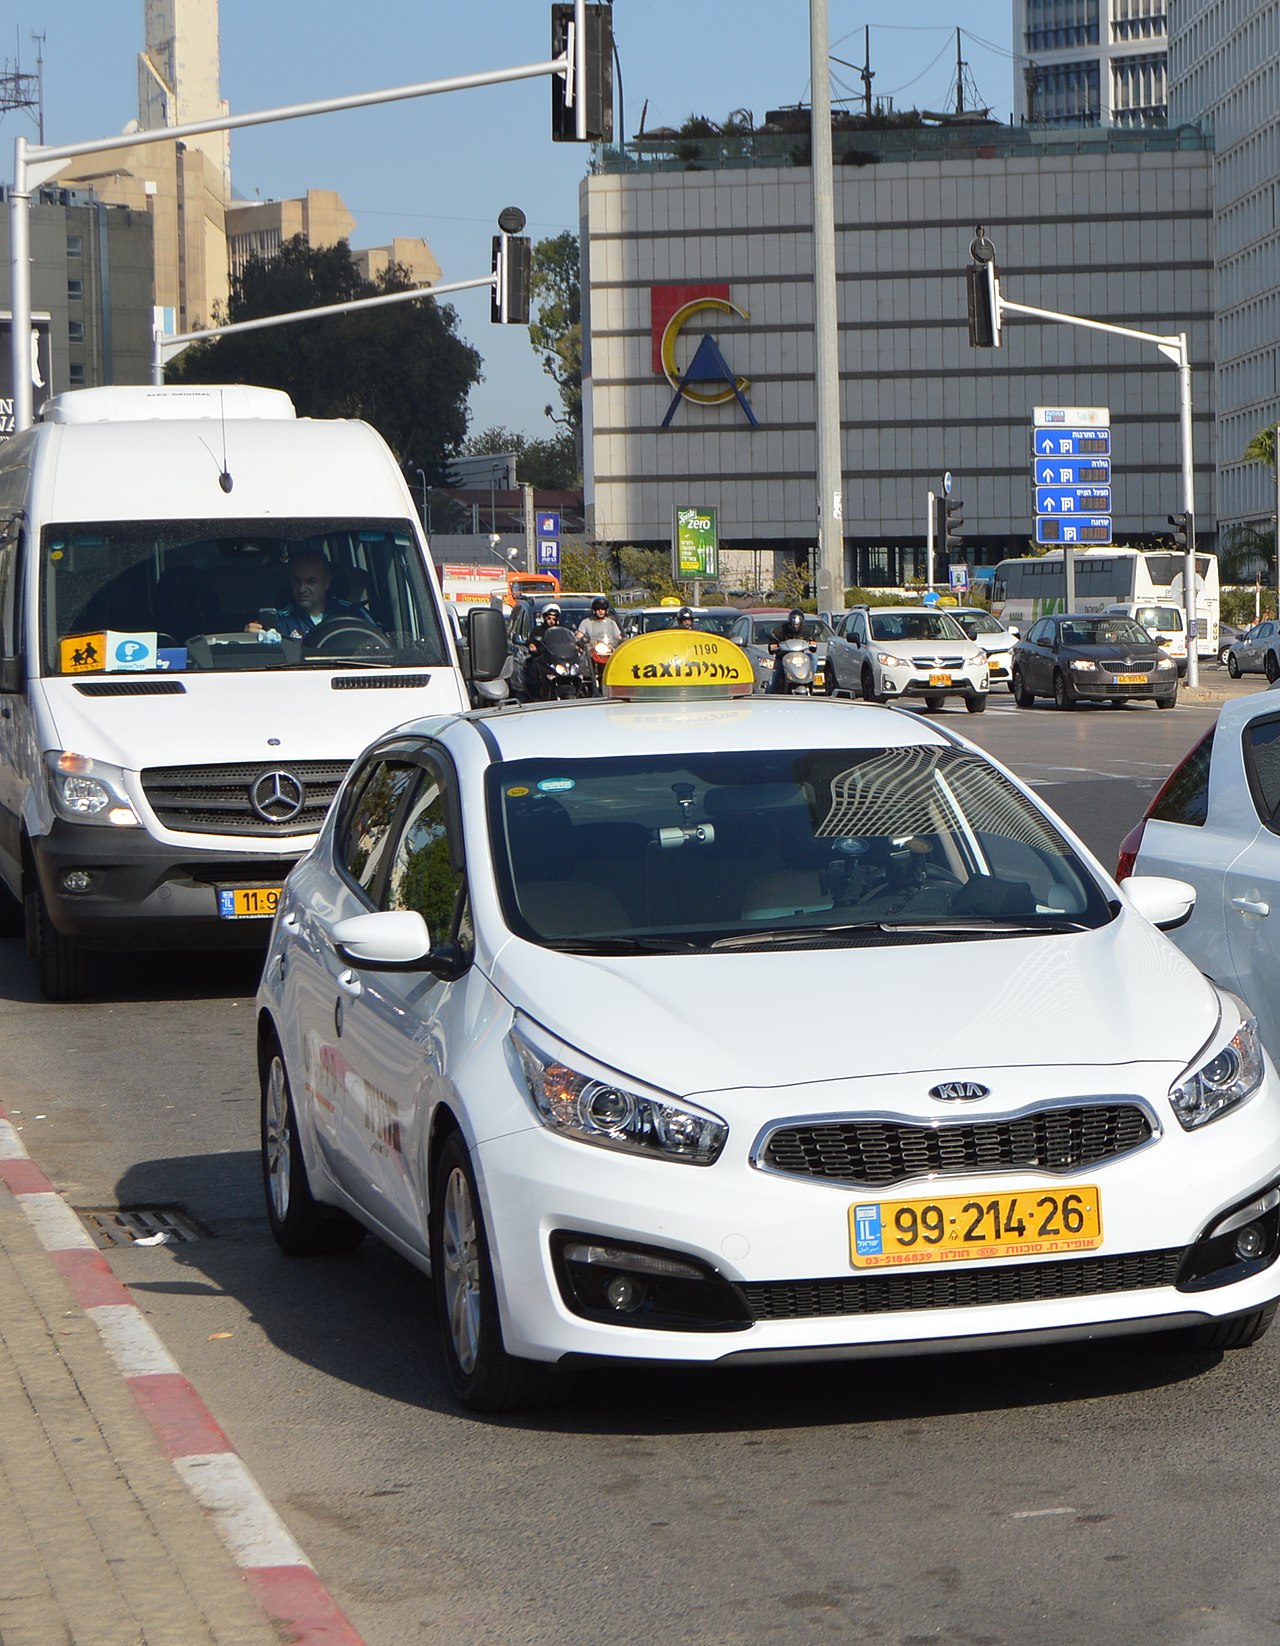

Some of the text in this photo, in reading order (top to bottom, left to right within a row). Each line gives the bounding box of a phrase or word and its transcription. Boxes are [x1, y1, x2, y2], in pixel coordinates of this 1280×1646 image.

[687, 519, 711, 529] zero
[693, 643, 718, 655] 1190
[631, 655, 740, 680] taxi מונית
[937, 1083, 983, 1099] KIA
[858, 1221, 875, 1241] IL
[1005, 1242, 1043, 1255] סוכנות
[865, 1251, 932, 1265] 03-5186839
[940, 1249, 970, 1263] חולון
